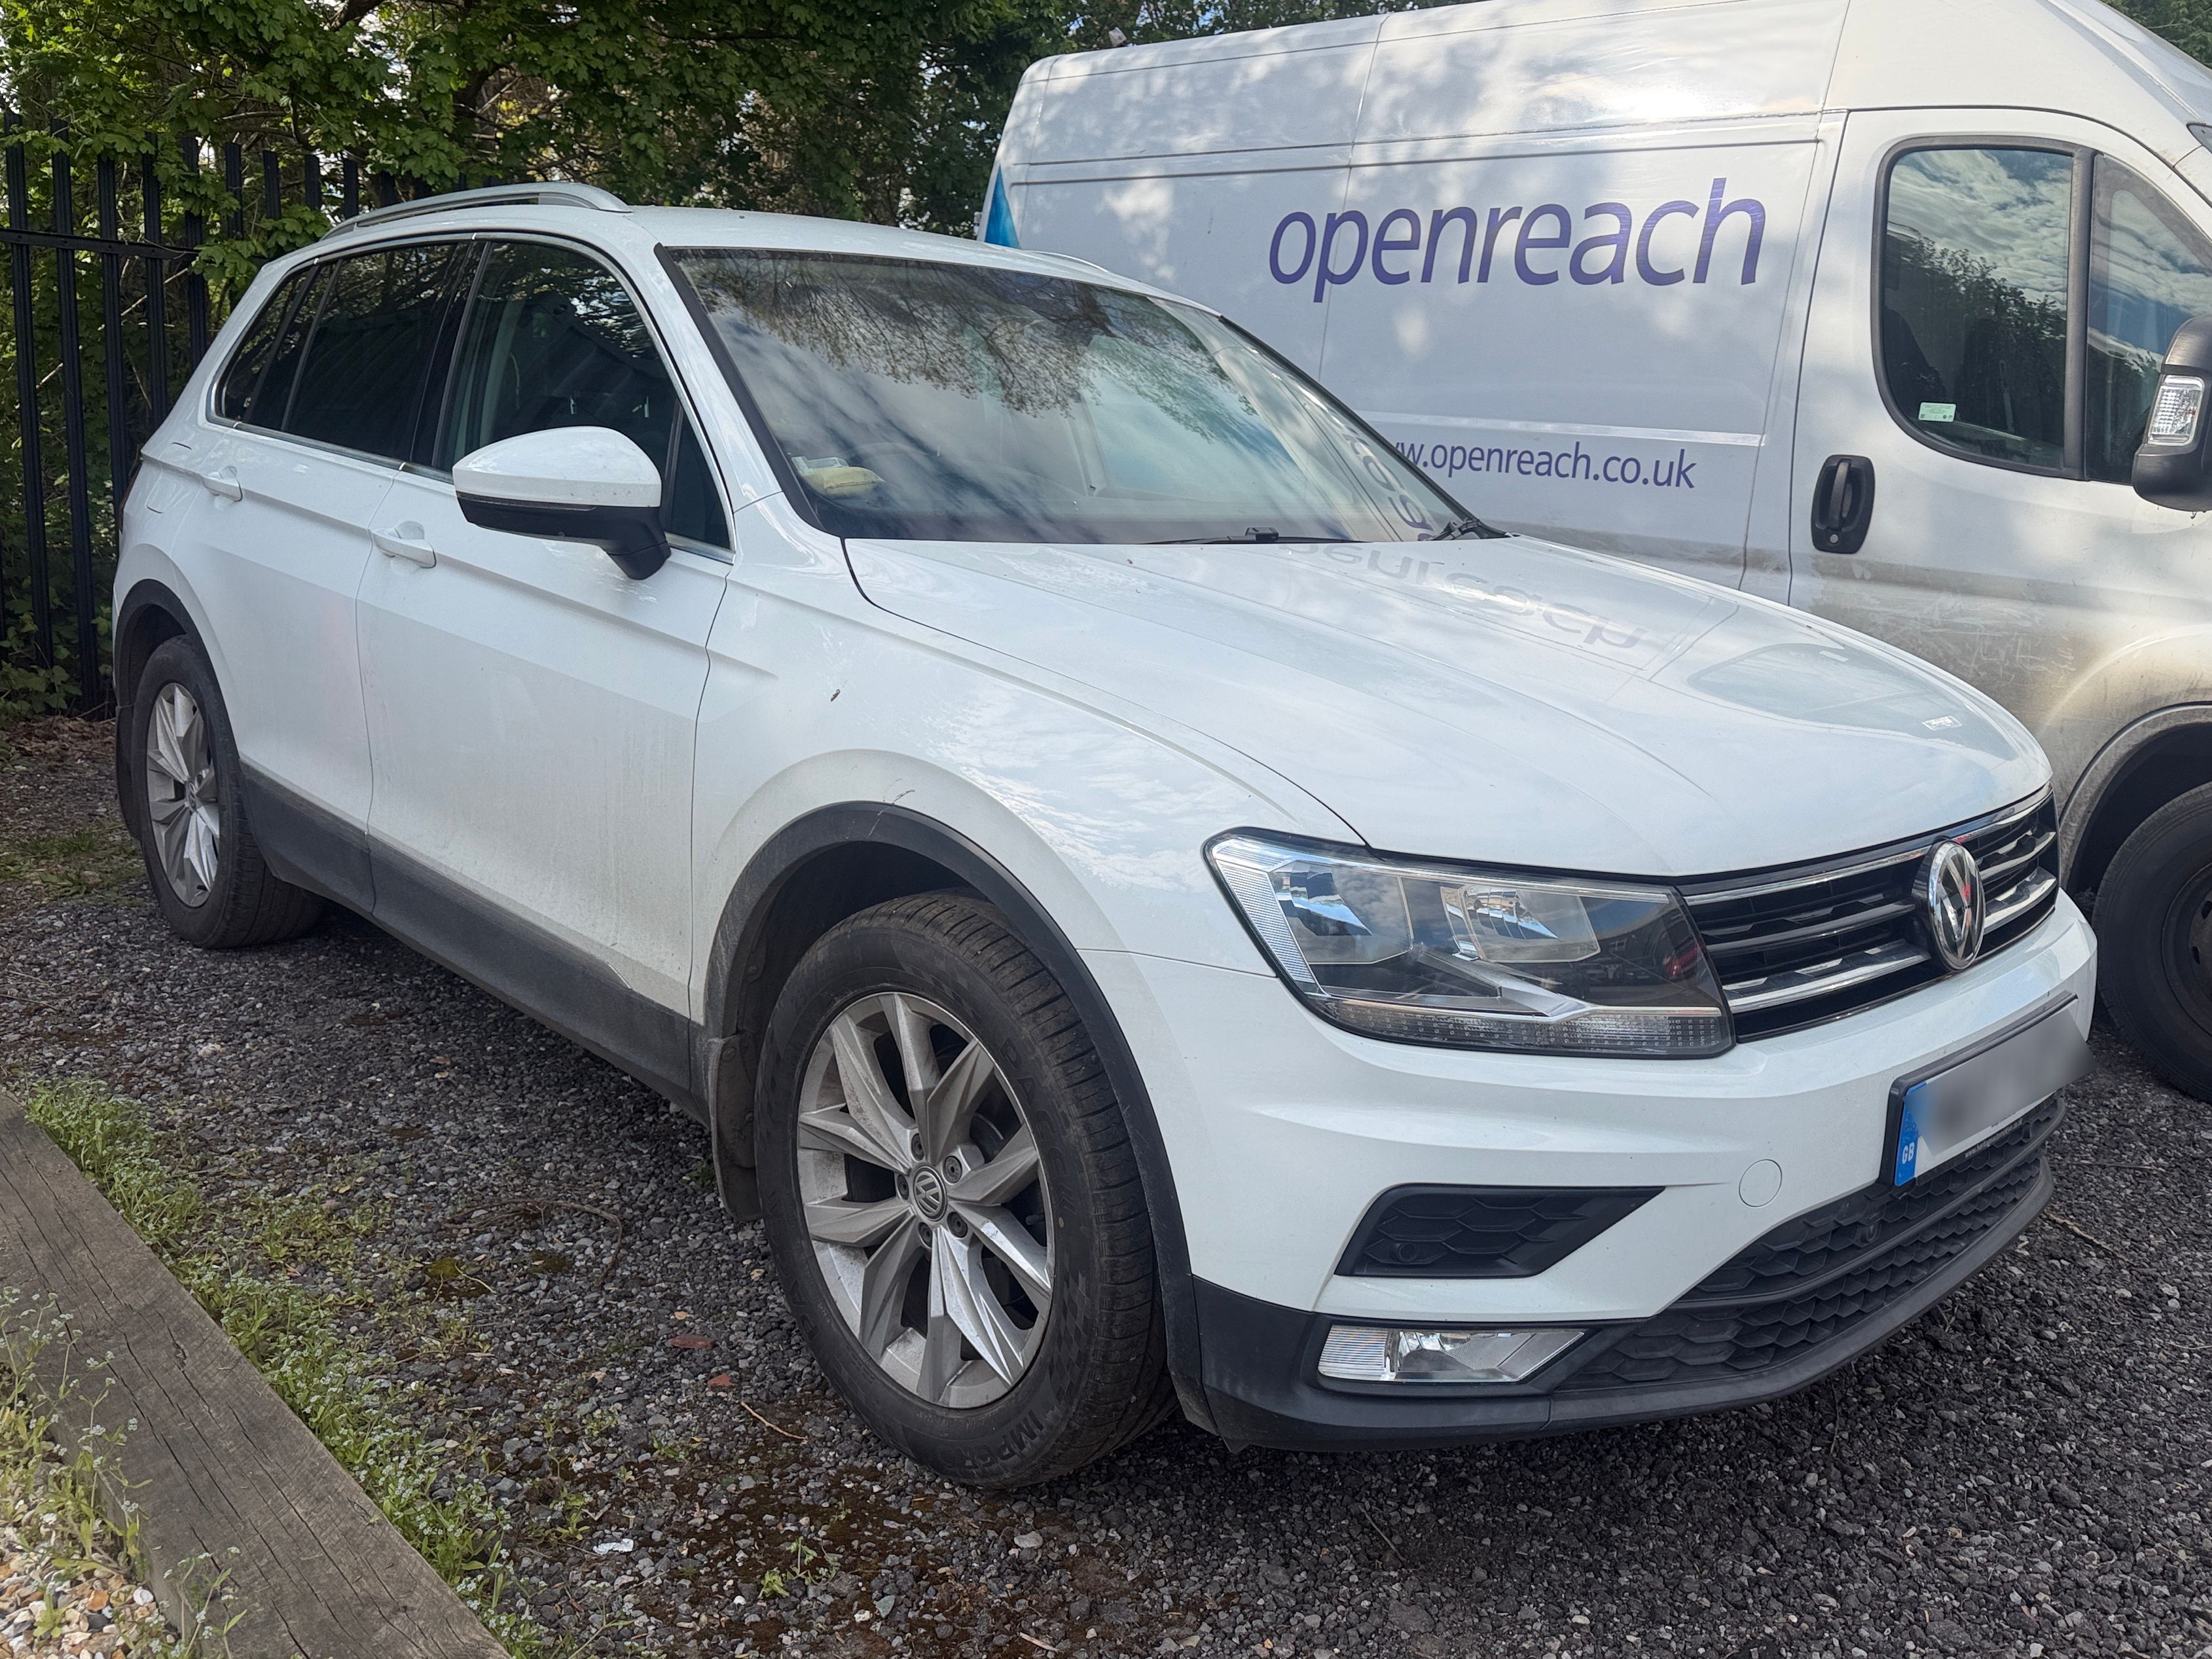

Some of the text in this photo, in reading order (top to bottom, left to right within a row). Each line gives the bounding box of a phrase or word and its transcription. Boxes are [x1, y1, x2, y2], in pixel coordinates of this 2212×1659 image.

[1269, 177, 1766, 304] openreach
[1396, 441, 1697, 489] w.openreach.co.uk
[1902, 1141, 1915, 1164] GB
